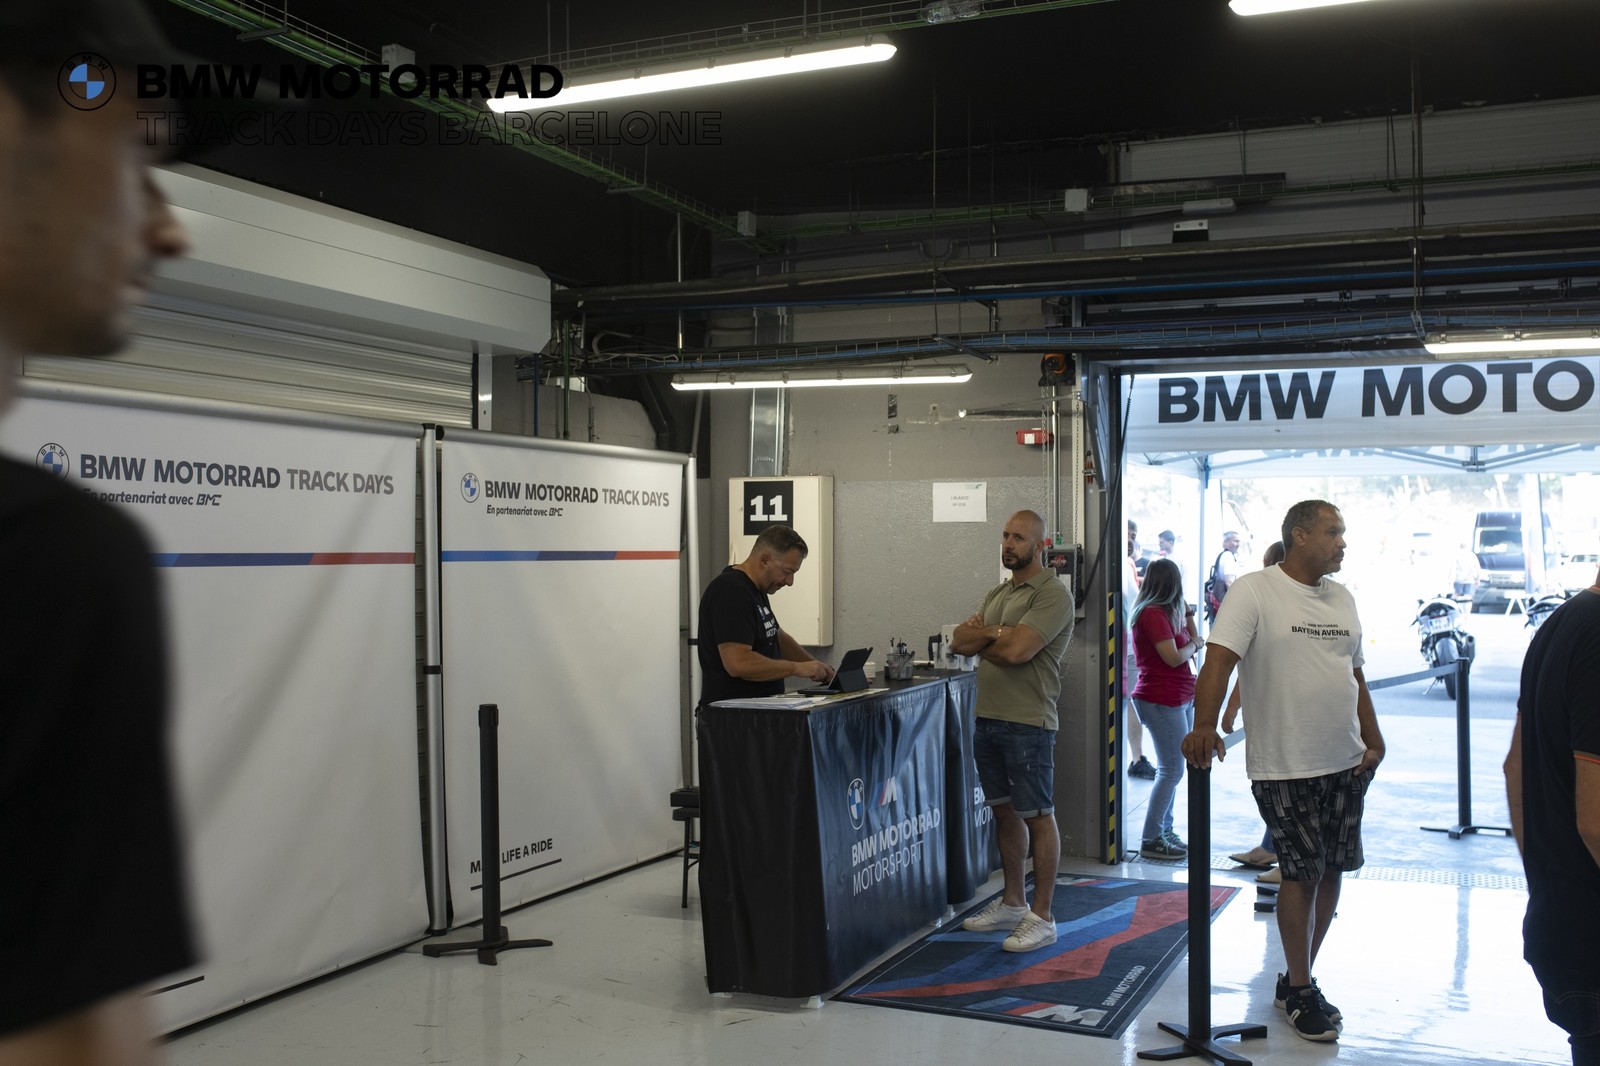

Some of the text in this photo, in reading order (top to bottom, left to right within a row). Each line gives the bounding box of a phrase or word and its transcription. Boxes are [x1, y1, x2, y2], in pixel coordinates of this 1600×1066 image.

[1158, 371, 1336, 423] BMW
[80, 454, 394, 495] BMW MOTORRAD TRACK DAYS
[100, 491, 169, 504] partenariat
[169, 495, 194, 506] avec
[484, 480, 669, 508] BMW MOTORRAD TRACK DAYS
[486, 504, 495, 514] En
[496, 506, 533, 517] partenariat
[533, 508, 548, 516] avec
[750, 495, 788, 522] 11
[1291, 626, 1350, 637] BAYERN AVENUE
[502, 838, 553, 864] LIFE A RIDE
[851, 833, 877, 867] BMW
[879, 808, 941, 852] MOTORRAD
[853, 840, 924, 897] MOTORSPORT
